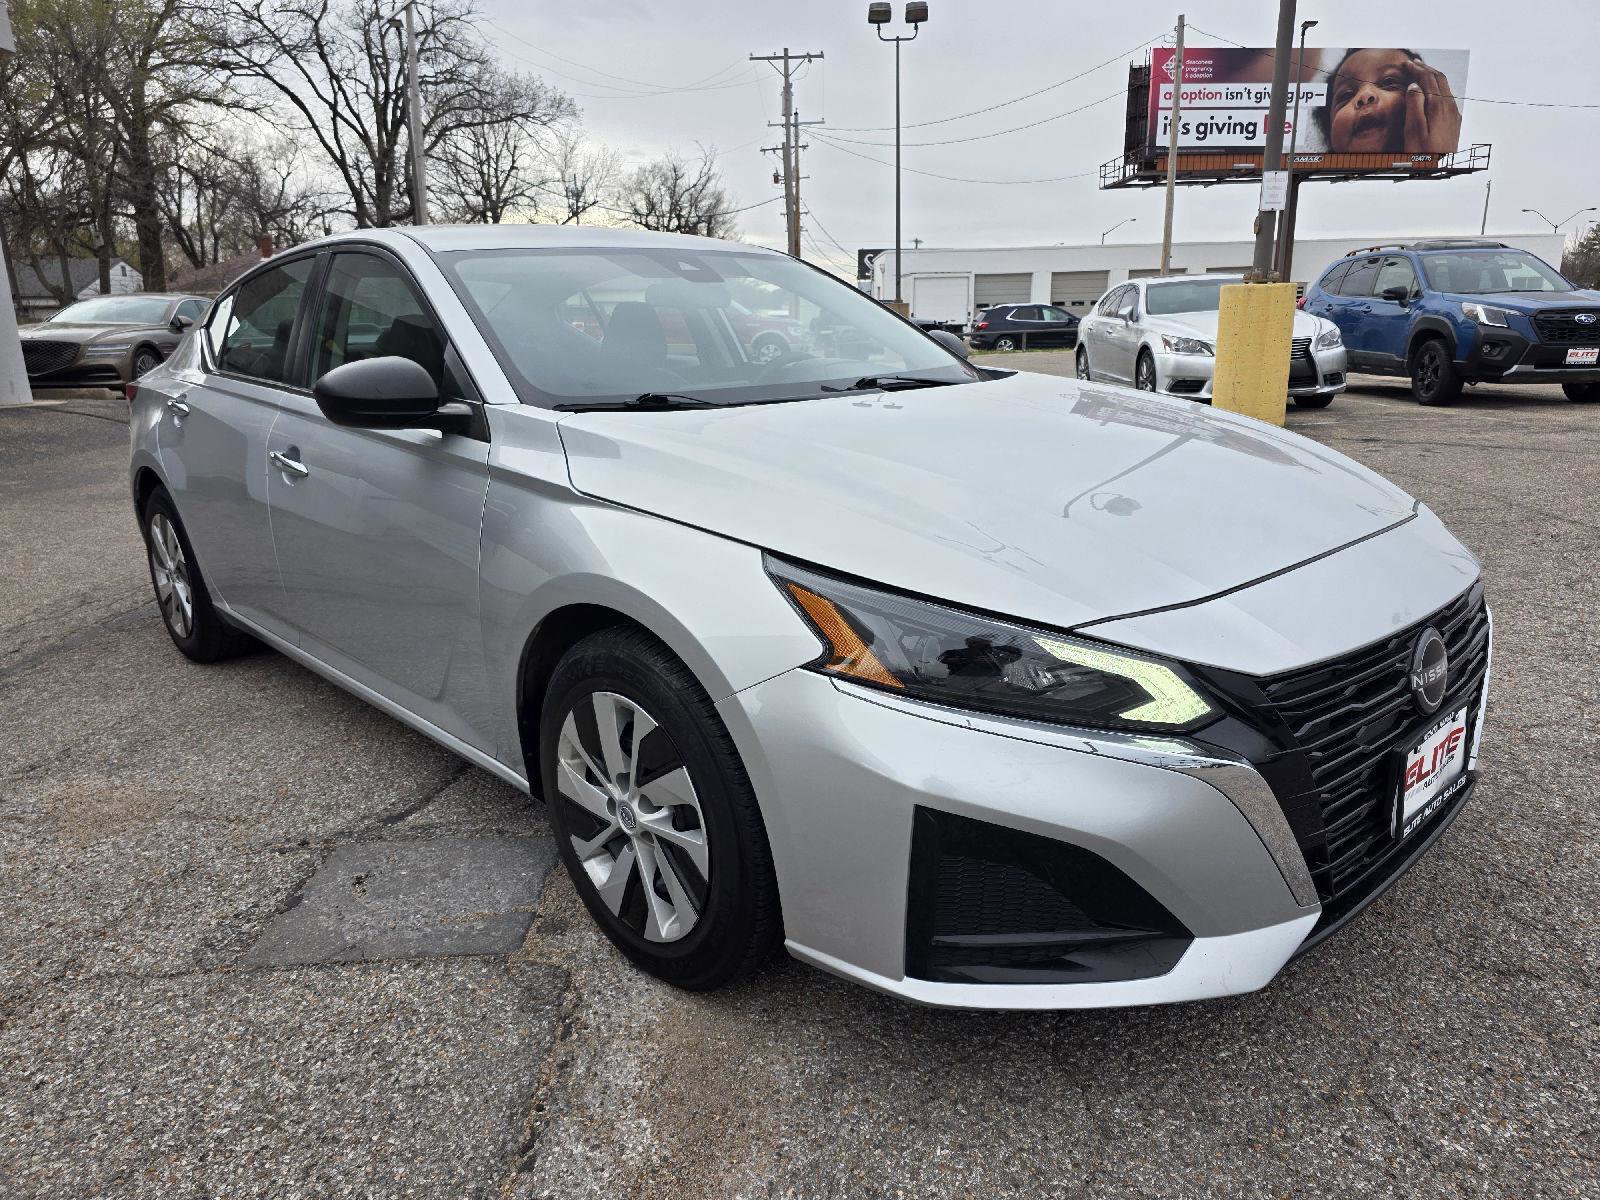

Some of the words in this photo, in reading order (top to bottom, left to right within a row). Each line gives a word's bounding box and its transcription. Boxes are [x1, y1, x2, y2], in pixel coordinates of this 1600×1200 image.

[1163, 87, 1223, 104] aoption
[1225, 87, 1252, 100] isn't
[1254, 86, 1294, 104] givg
[1195, 115, 1258, 141] giving
[1263, 114, 1293, 135] le
[1403, 726, 1465, 793] ELITE
[1422, 795, 1443, 820] AUTO
[1443, 774, 1467, 801] SALES
